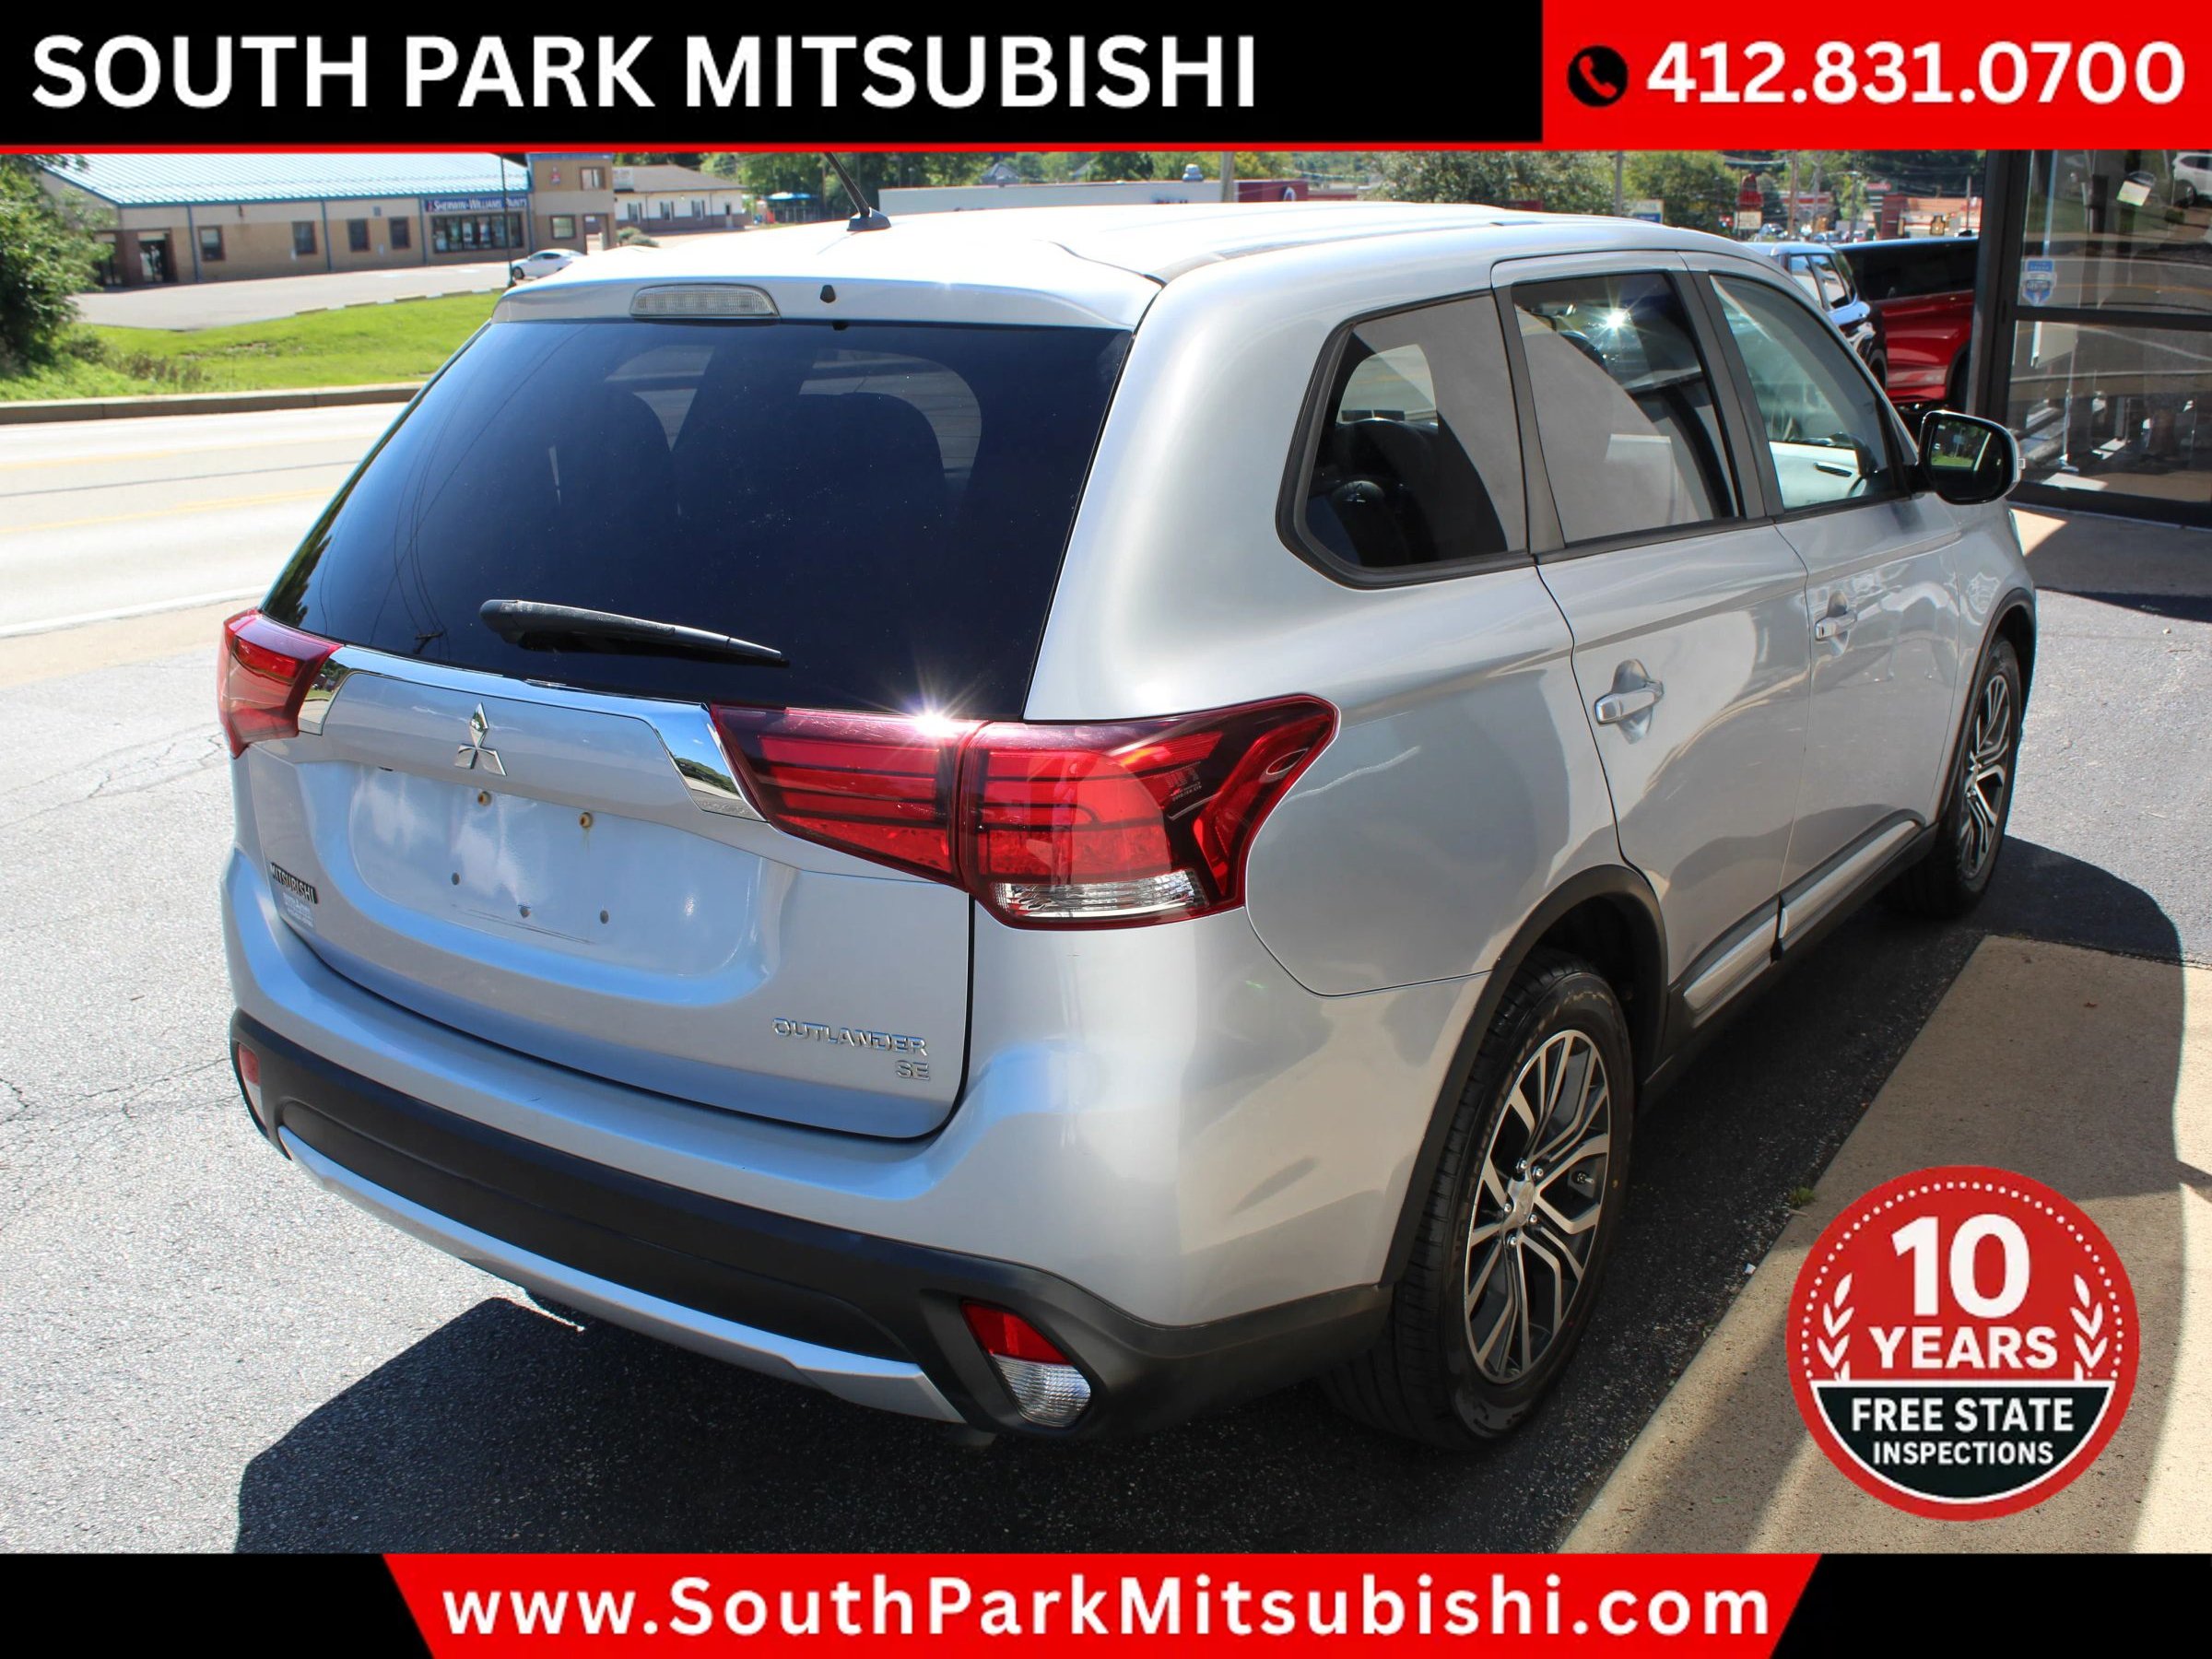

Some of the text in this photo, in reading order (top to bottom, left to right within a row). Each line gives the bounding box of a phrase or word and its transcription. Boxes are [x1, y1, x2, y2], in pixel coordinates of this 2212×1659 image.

[270, 863, 317, 903] MITSUBISHI
[772, 1017, 928, 1056] OUTLANDER
[895, 1059, 930, 1081] SE
